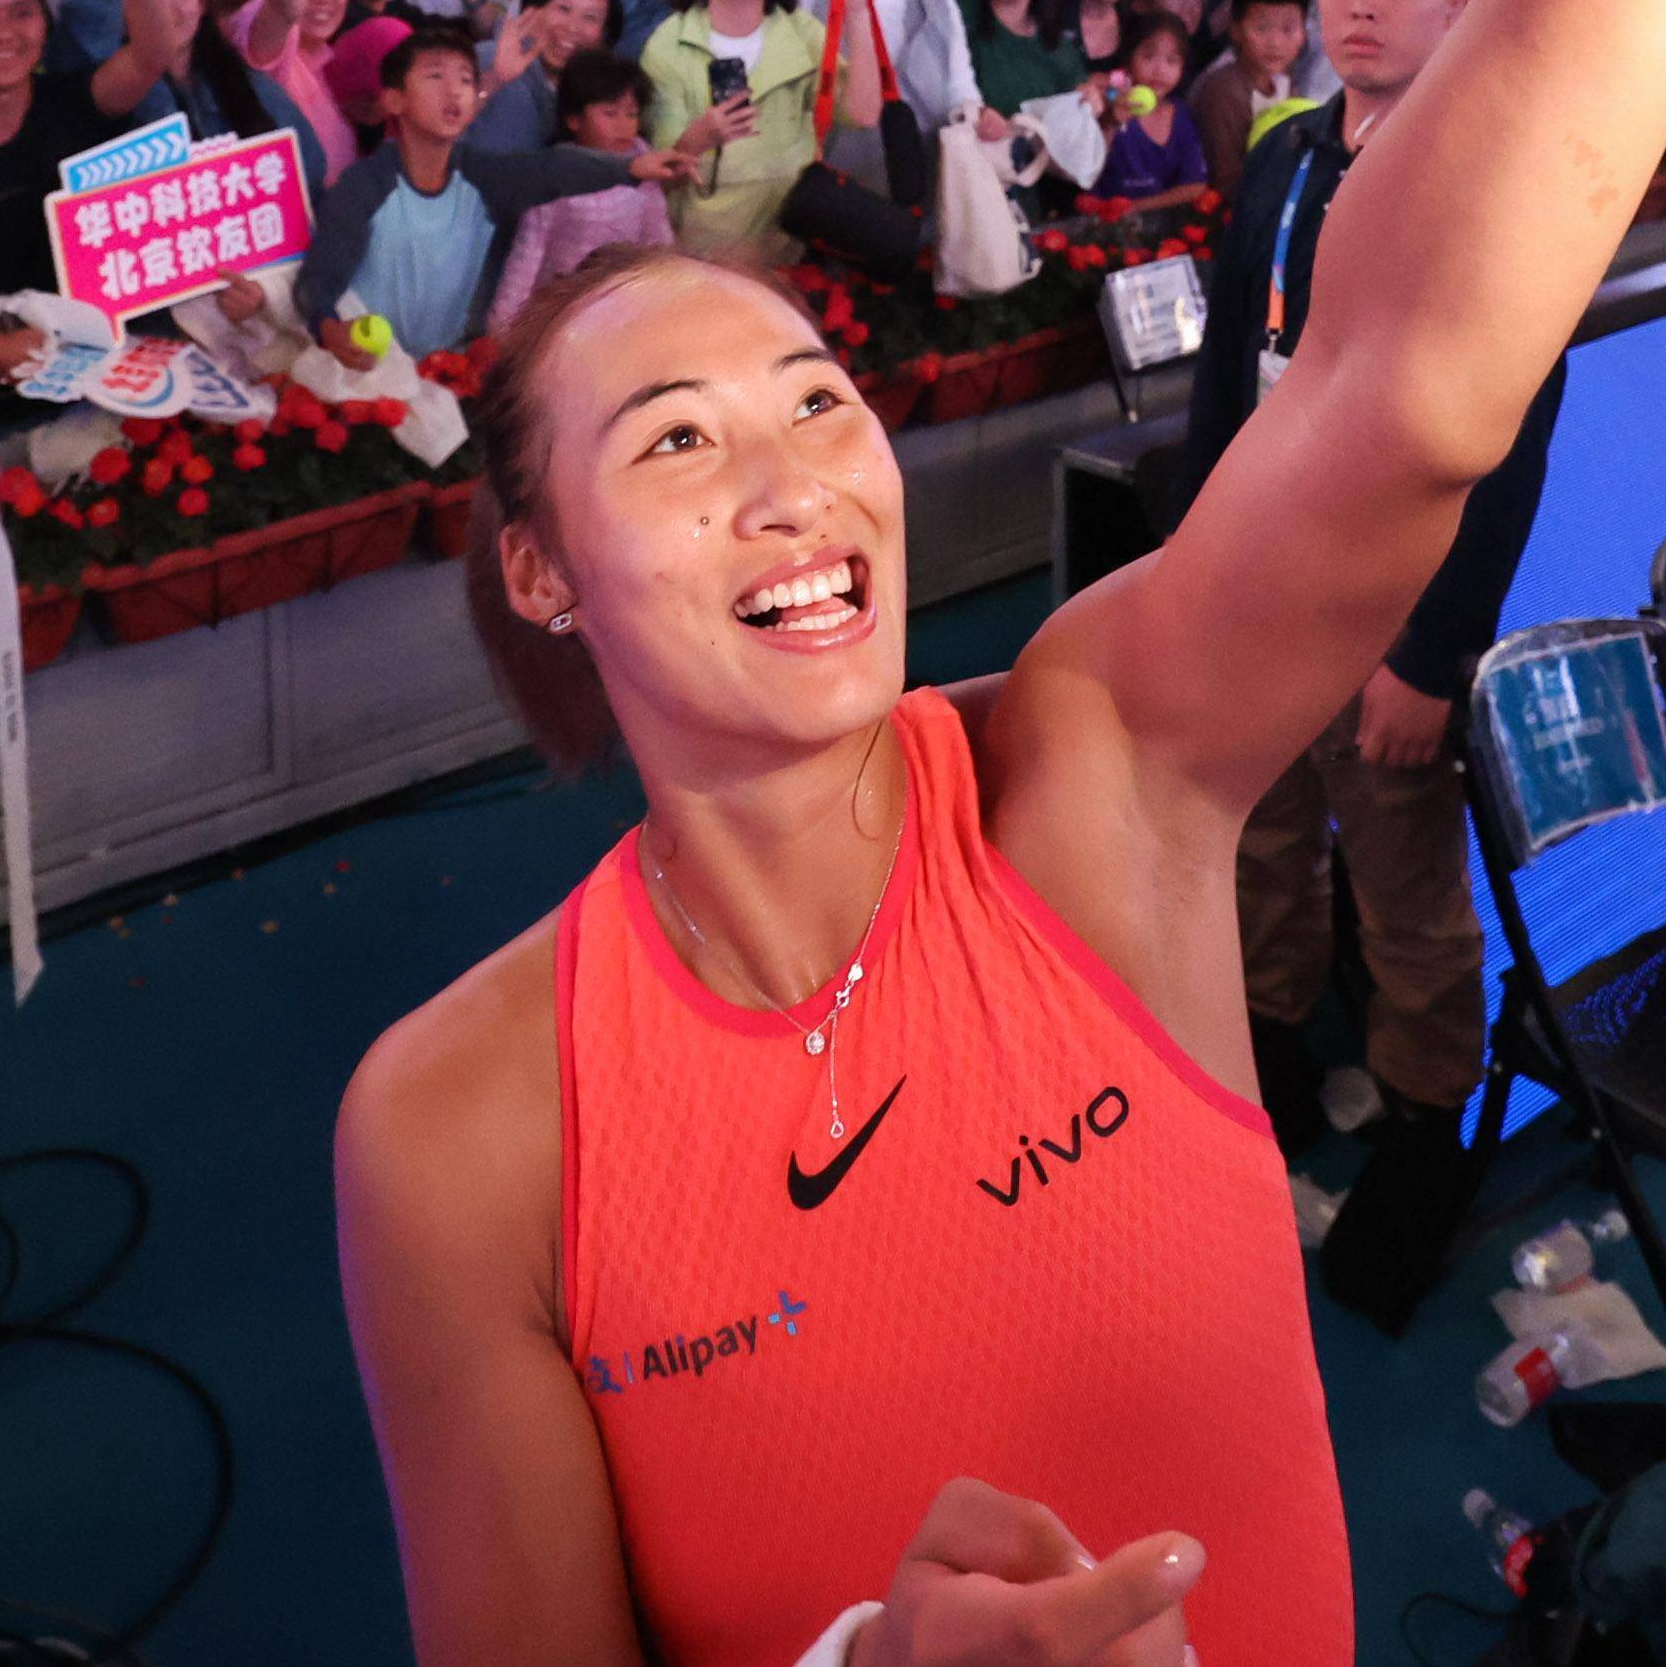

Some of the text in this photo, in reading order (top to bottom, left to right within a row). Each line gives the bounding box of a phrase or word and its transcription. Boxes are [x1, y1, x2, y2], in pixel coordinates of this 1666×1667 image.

[74, 150, 286, 248] 华中科技大学
[976, 1086, 1130, 1207] vivo
